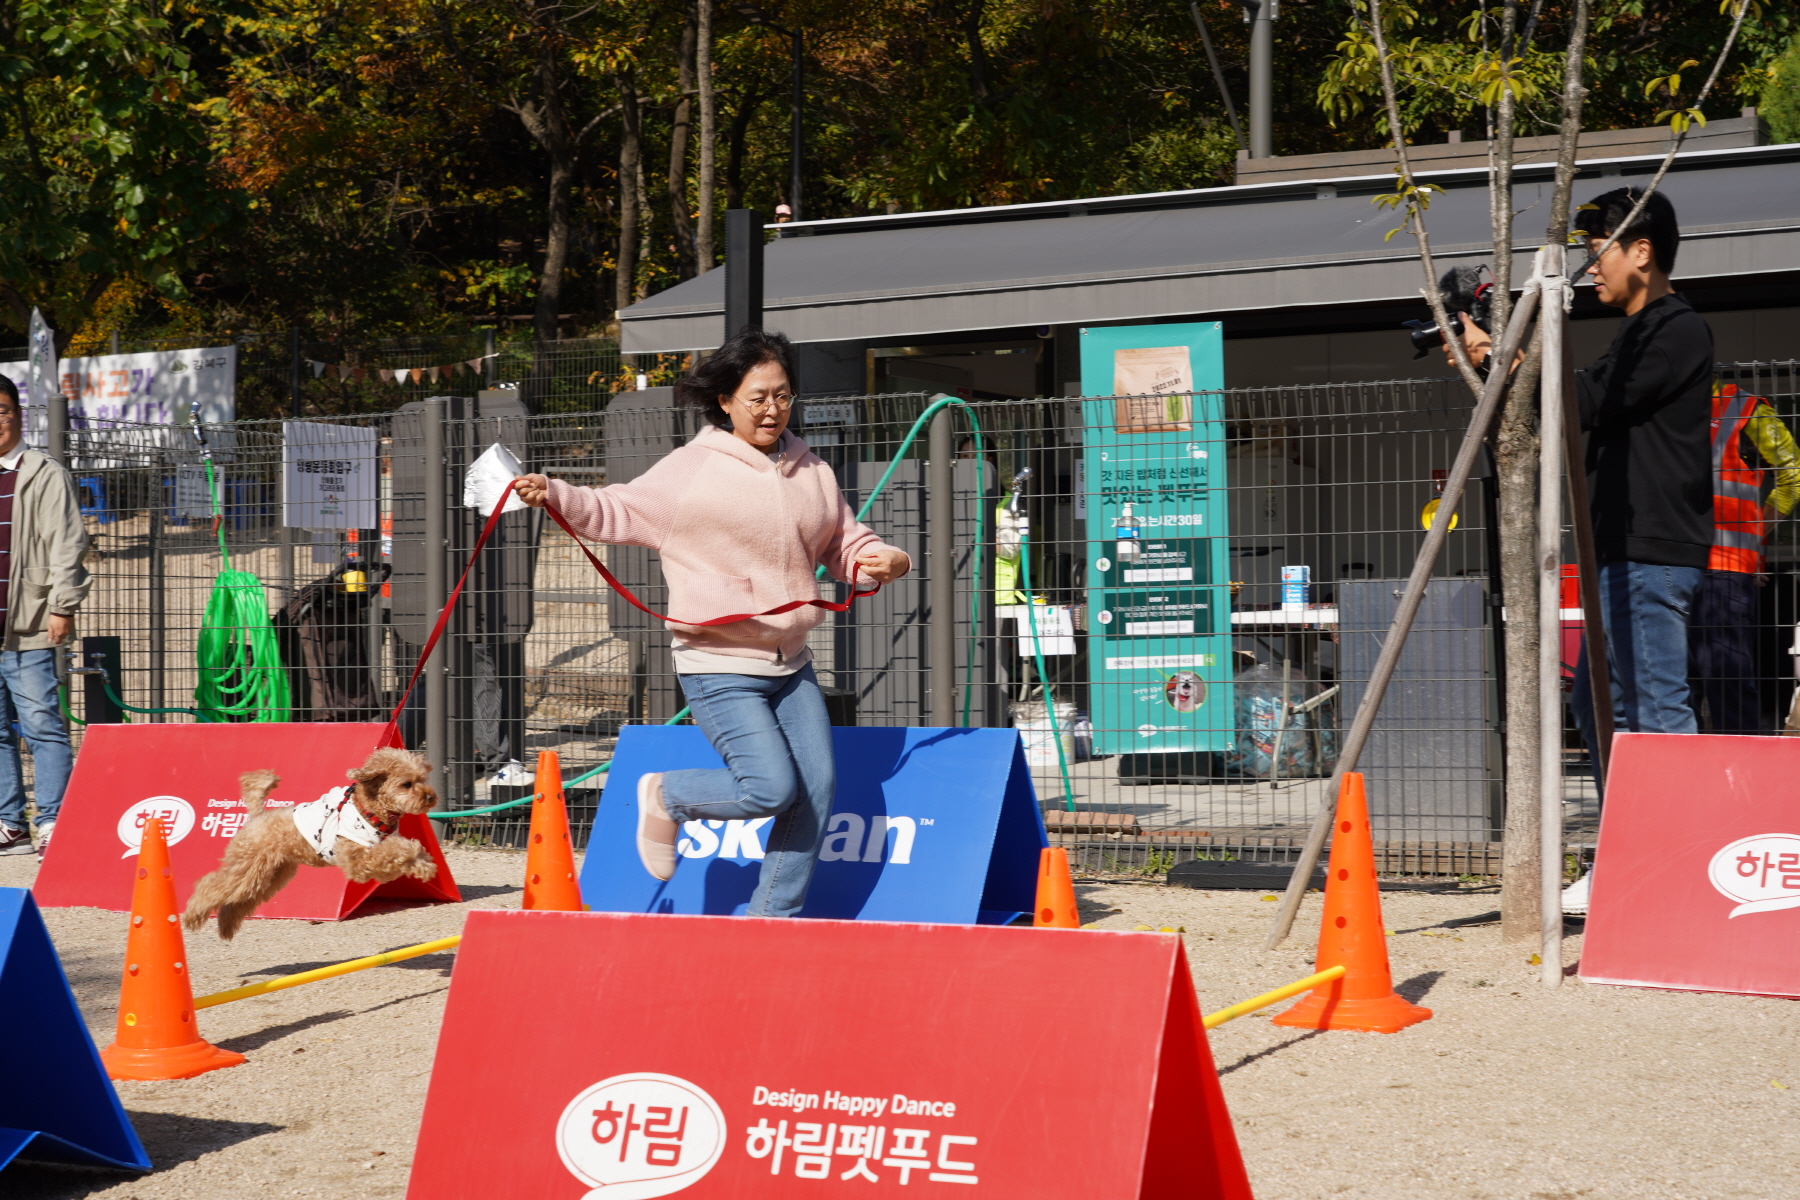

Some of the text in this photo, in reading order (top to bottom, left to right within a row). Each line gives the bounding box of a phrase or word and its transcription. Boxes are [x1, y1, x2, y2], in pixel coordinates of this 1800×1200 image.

[193, 357, 227, 371] 강북구
[1102, 466, 1207, 481] 갓 지은 밥처럼 신선해서
[1102, 485, 1152, 505] 맛있는
[1158, 482, 1209, 503] 펫푸드
[207, 799, 238, 810] Design
[752, 1085, 956, 1118] Design Happy Dance
[591, 1100, 689, 1167] 하림
[745, 1117, 979, 1185] 하림펫푸드
